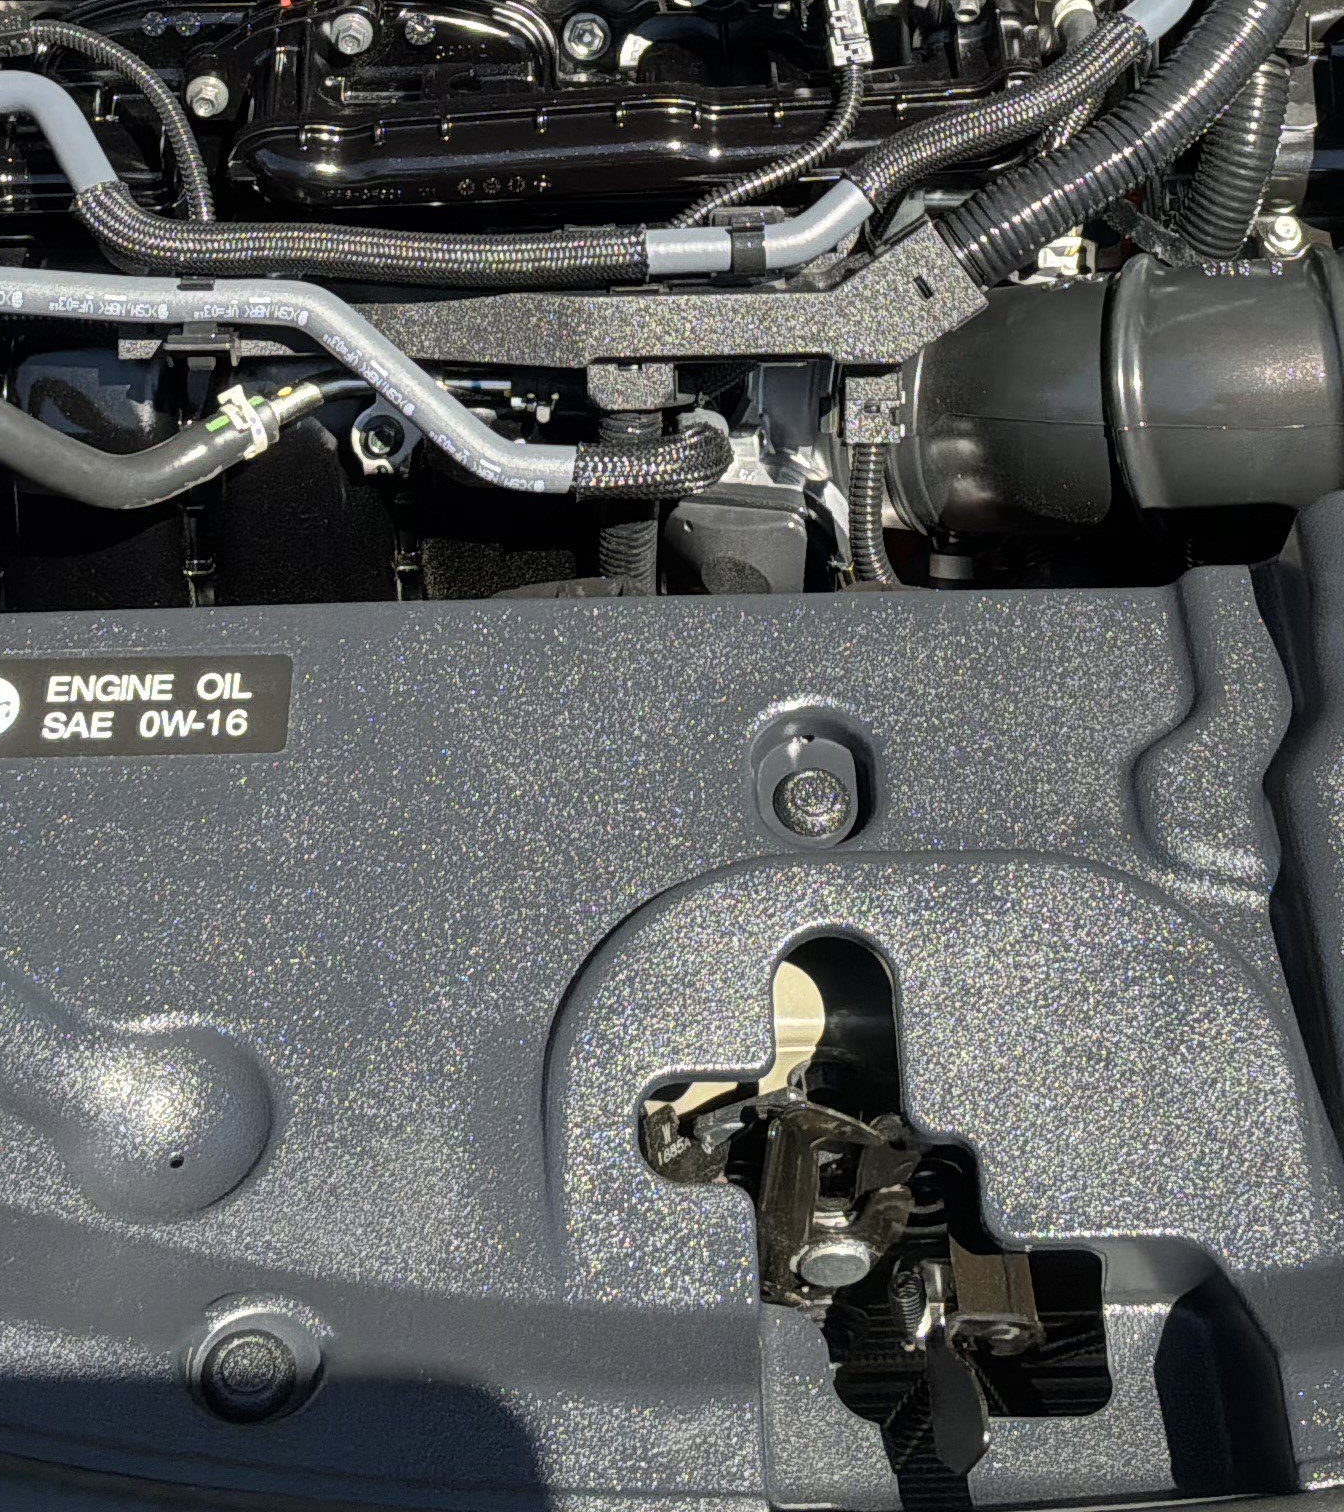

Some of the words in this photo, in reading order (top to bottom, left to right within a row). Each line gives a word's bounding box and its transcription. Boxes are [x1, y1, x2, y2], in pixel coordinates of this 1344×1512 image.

[45, 674, 175, 703] ENGINE
[196, 672, 253, 700] OIL
[41, 711, 115, 740] SAE
[139, 708, 249, 738] 0W-16
